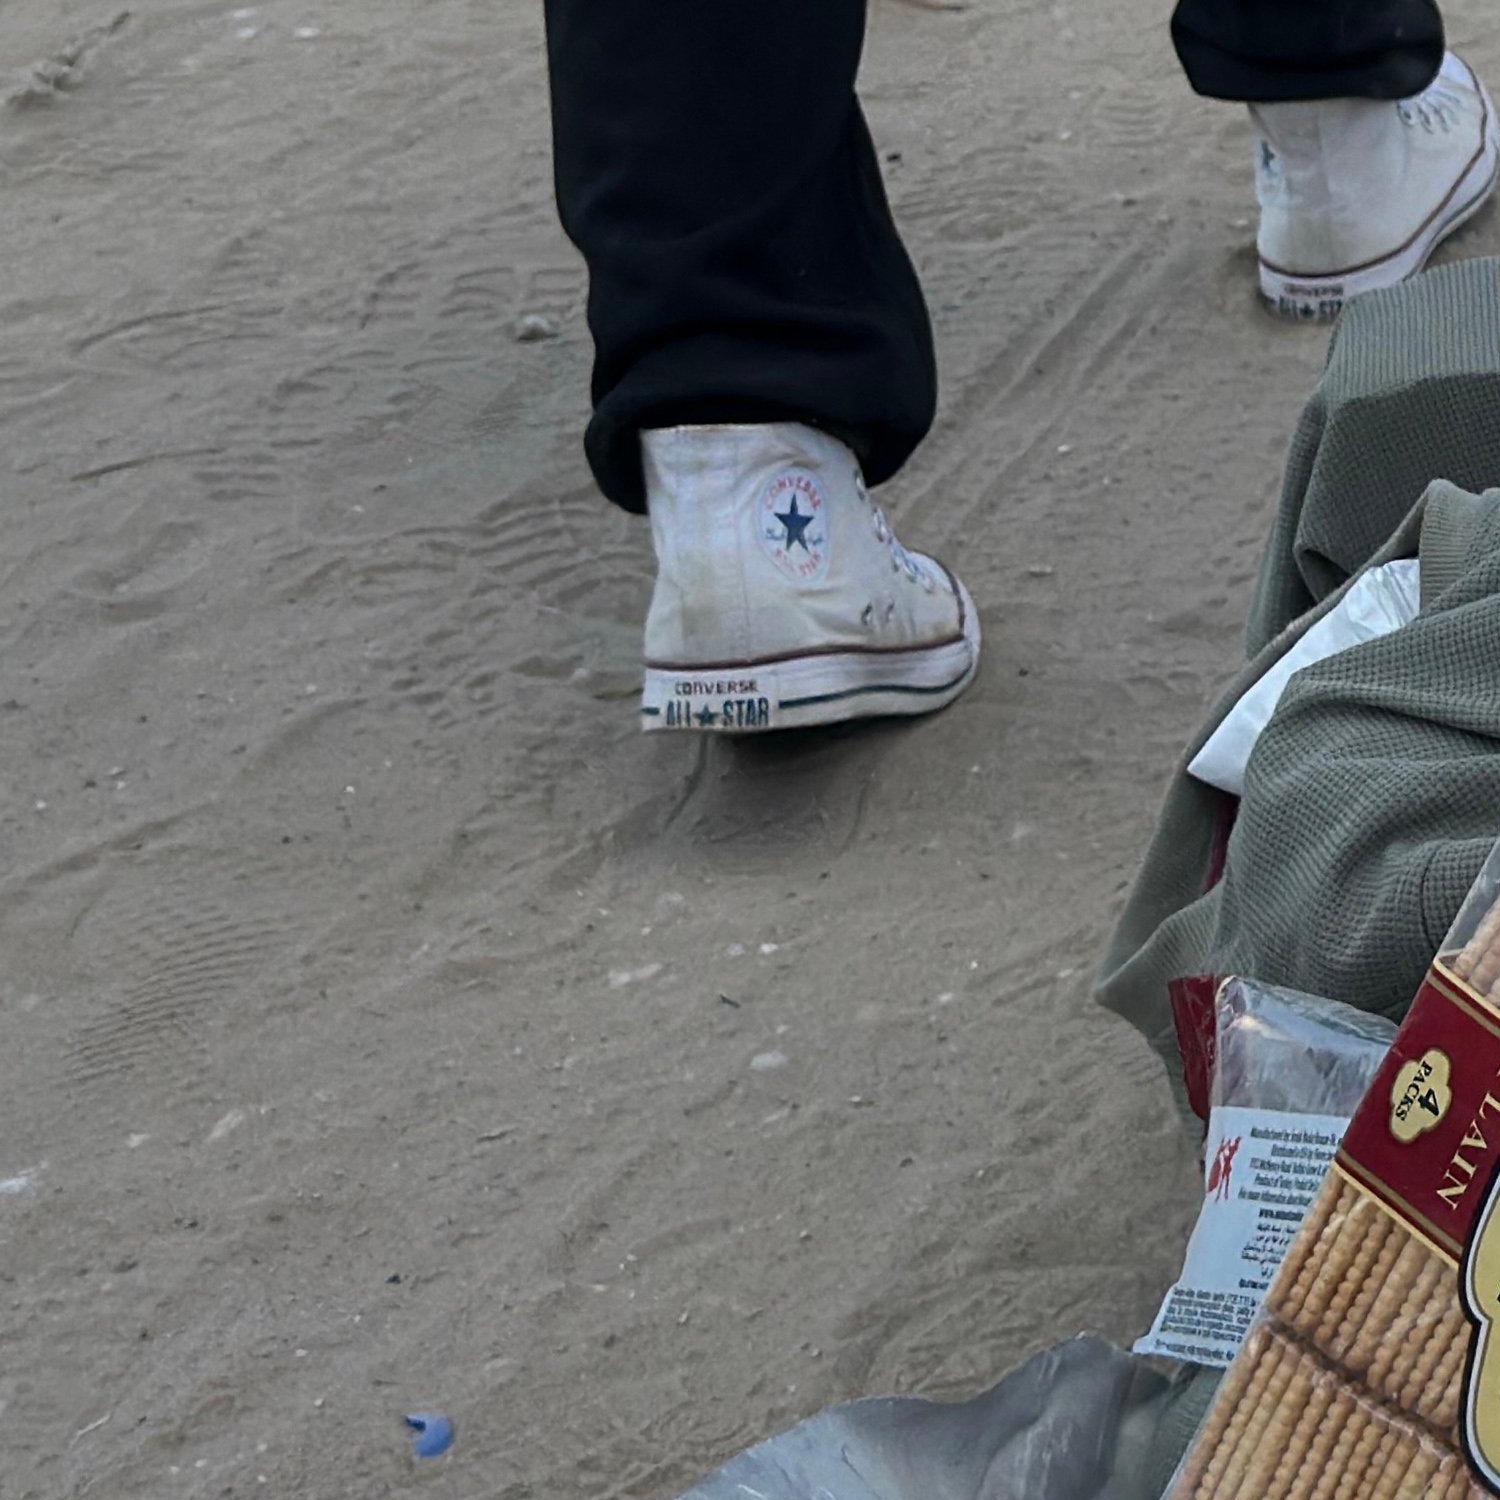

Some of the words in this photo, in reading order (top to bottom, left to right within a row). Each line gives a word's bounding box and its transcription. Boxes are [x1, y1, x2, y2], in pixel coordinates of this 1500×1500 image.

[674, 680, 760, 696] CONVERSE
[665, 698, 692, 728] ALL
[722, 697, 769, 727] STAR
[1390, 1057, 1434, 1123] PACKS
[1413, 1084, 1447, 1118] 4
